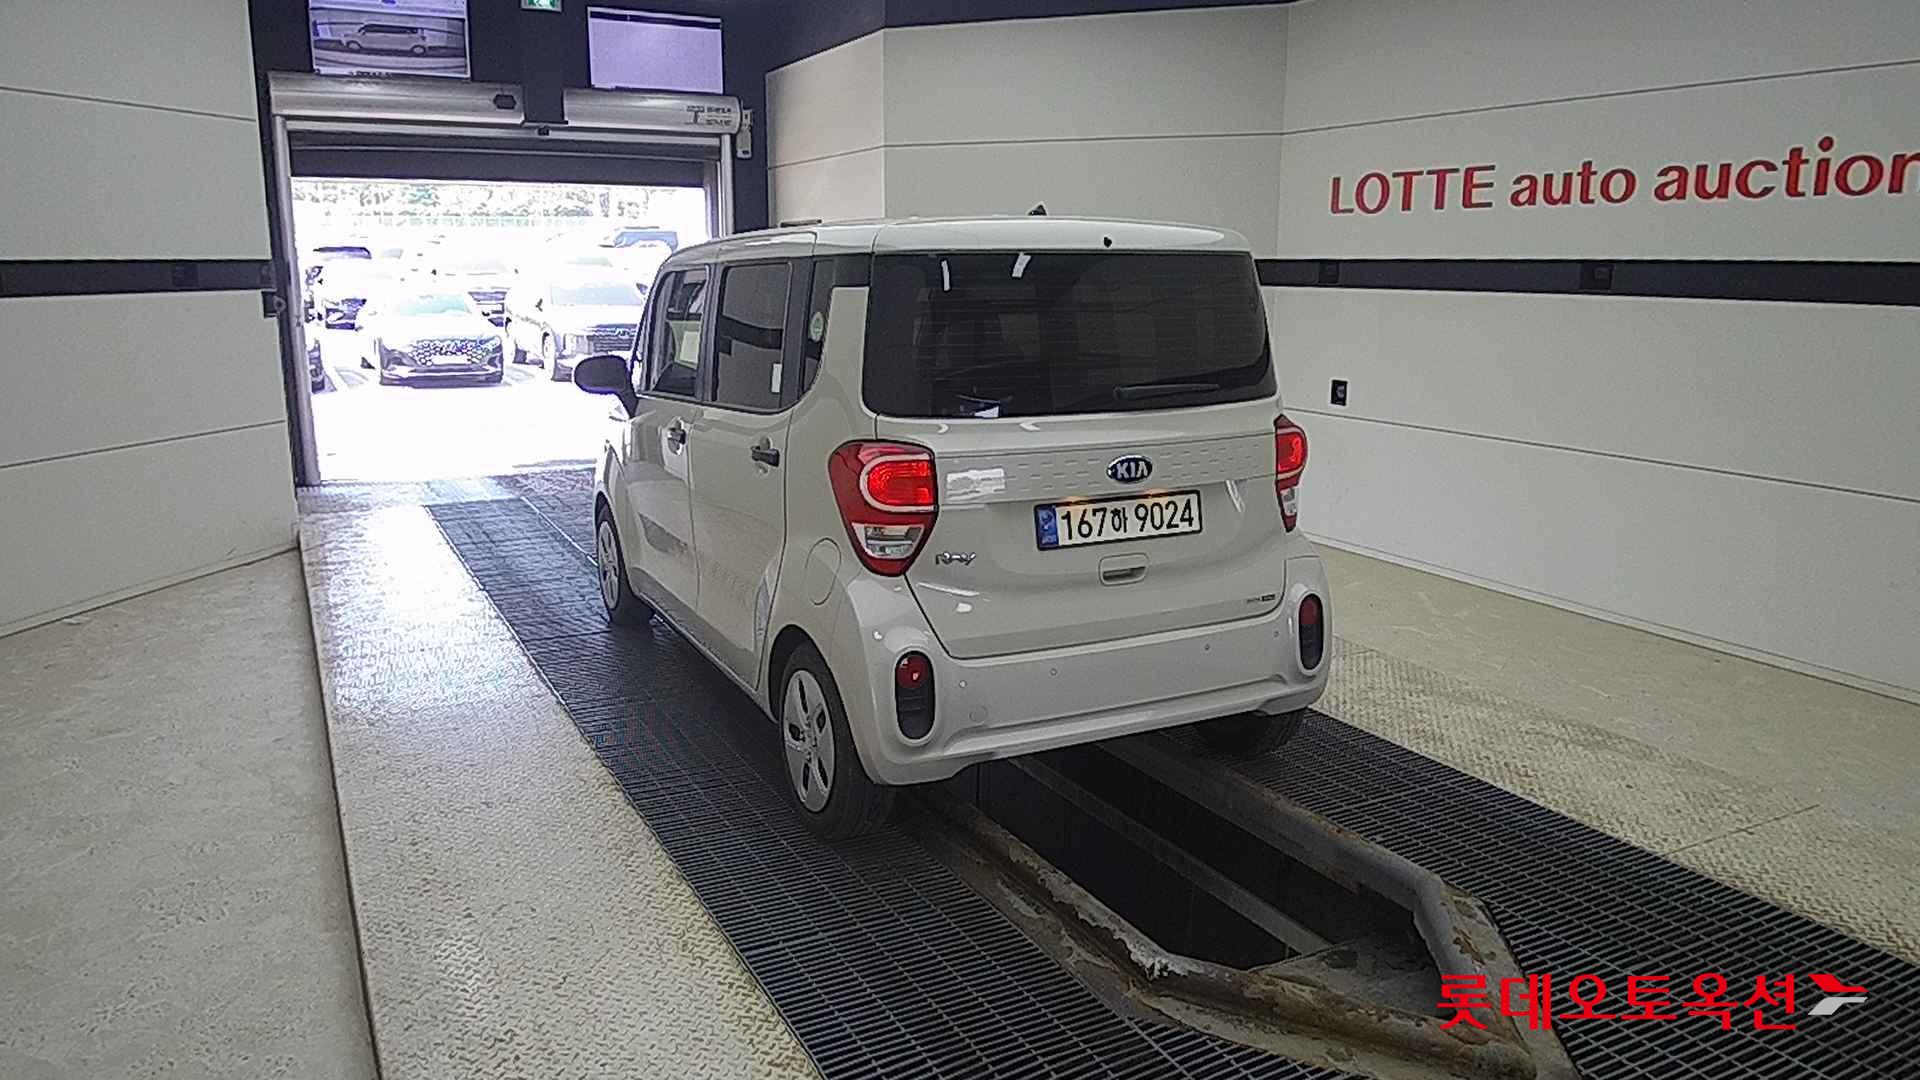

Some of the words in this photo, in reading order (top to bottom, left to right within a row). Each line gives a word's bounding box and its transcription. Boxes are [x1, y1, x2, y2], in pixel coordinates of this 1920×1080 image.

[1331, 165, 1496, 214] LOTTE
[1510, 161, 1636, 207] auto
[1115, 460, 1149, 479] KIA
[1061, 506, 1128, 540] 167하
[1134, 498, 1195, 532] 9024
